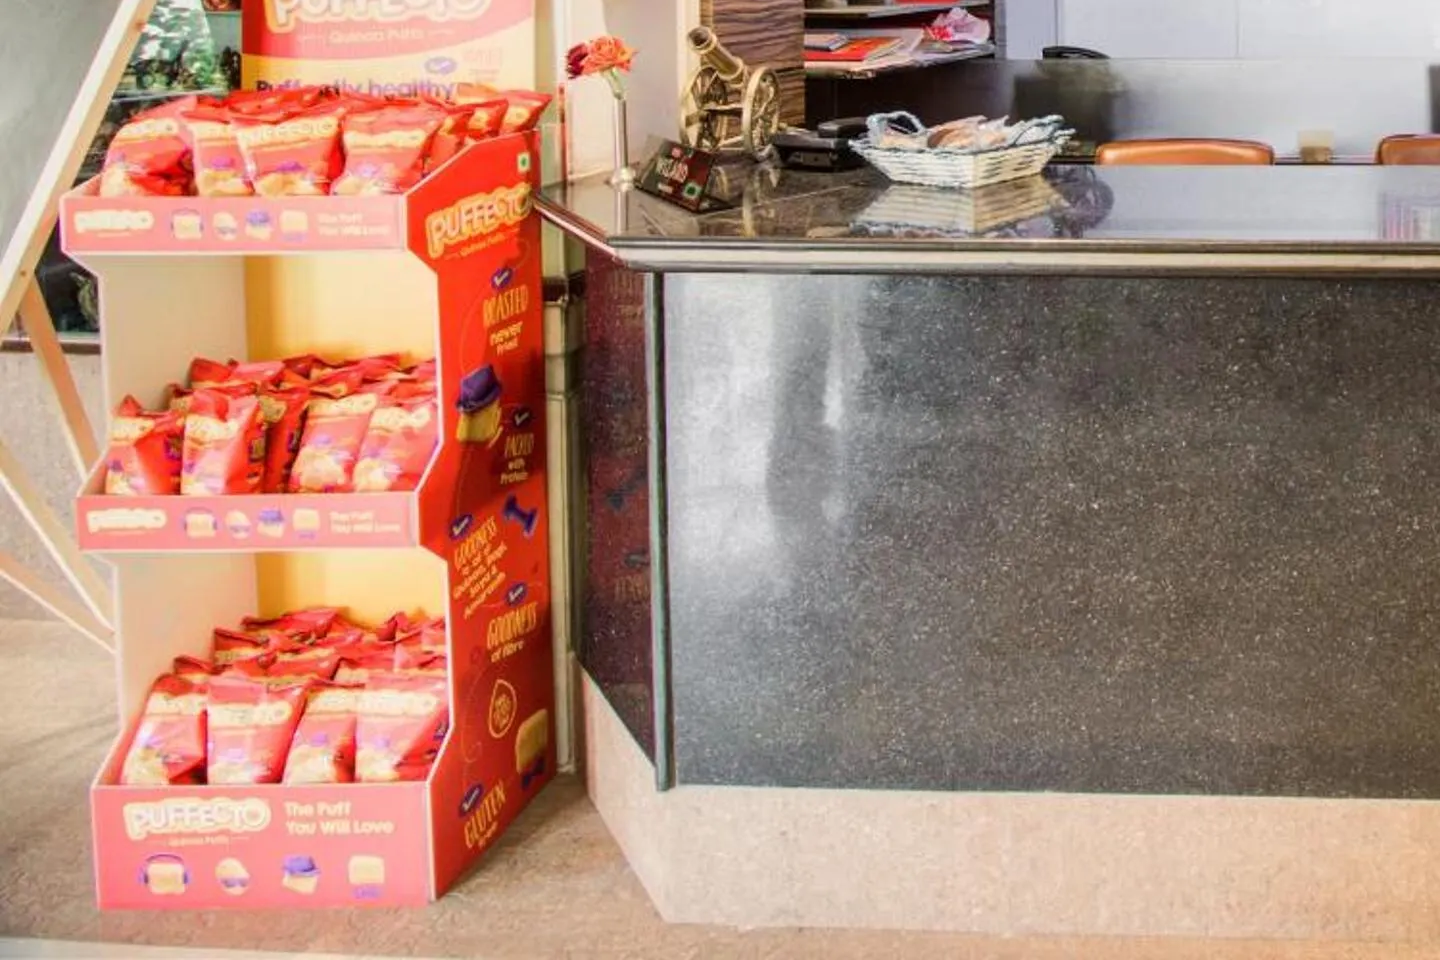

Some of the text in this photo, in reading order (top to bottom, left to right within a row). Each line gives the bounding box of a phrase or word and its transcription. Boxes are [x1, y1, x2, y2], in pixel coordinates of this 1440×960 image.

[428, 184, 533, 258] PUFFECTO
[127, 799, 352, 837] PUFFECTO The Puff
[286, 820, 395, 835] You Will Love
